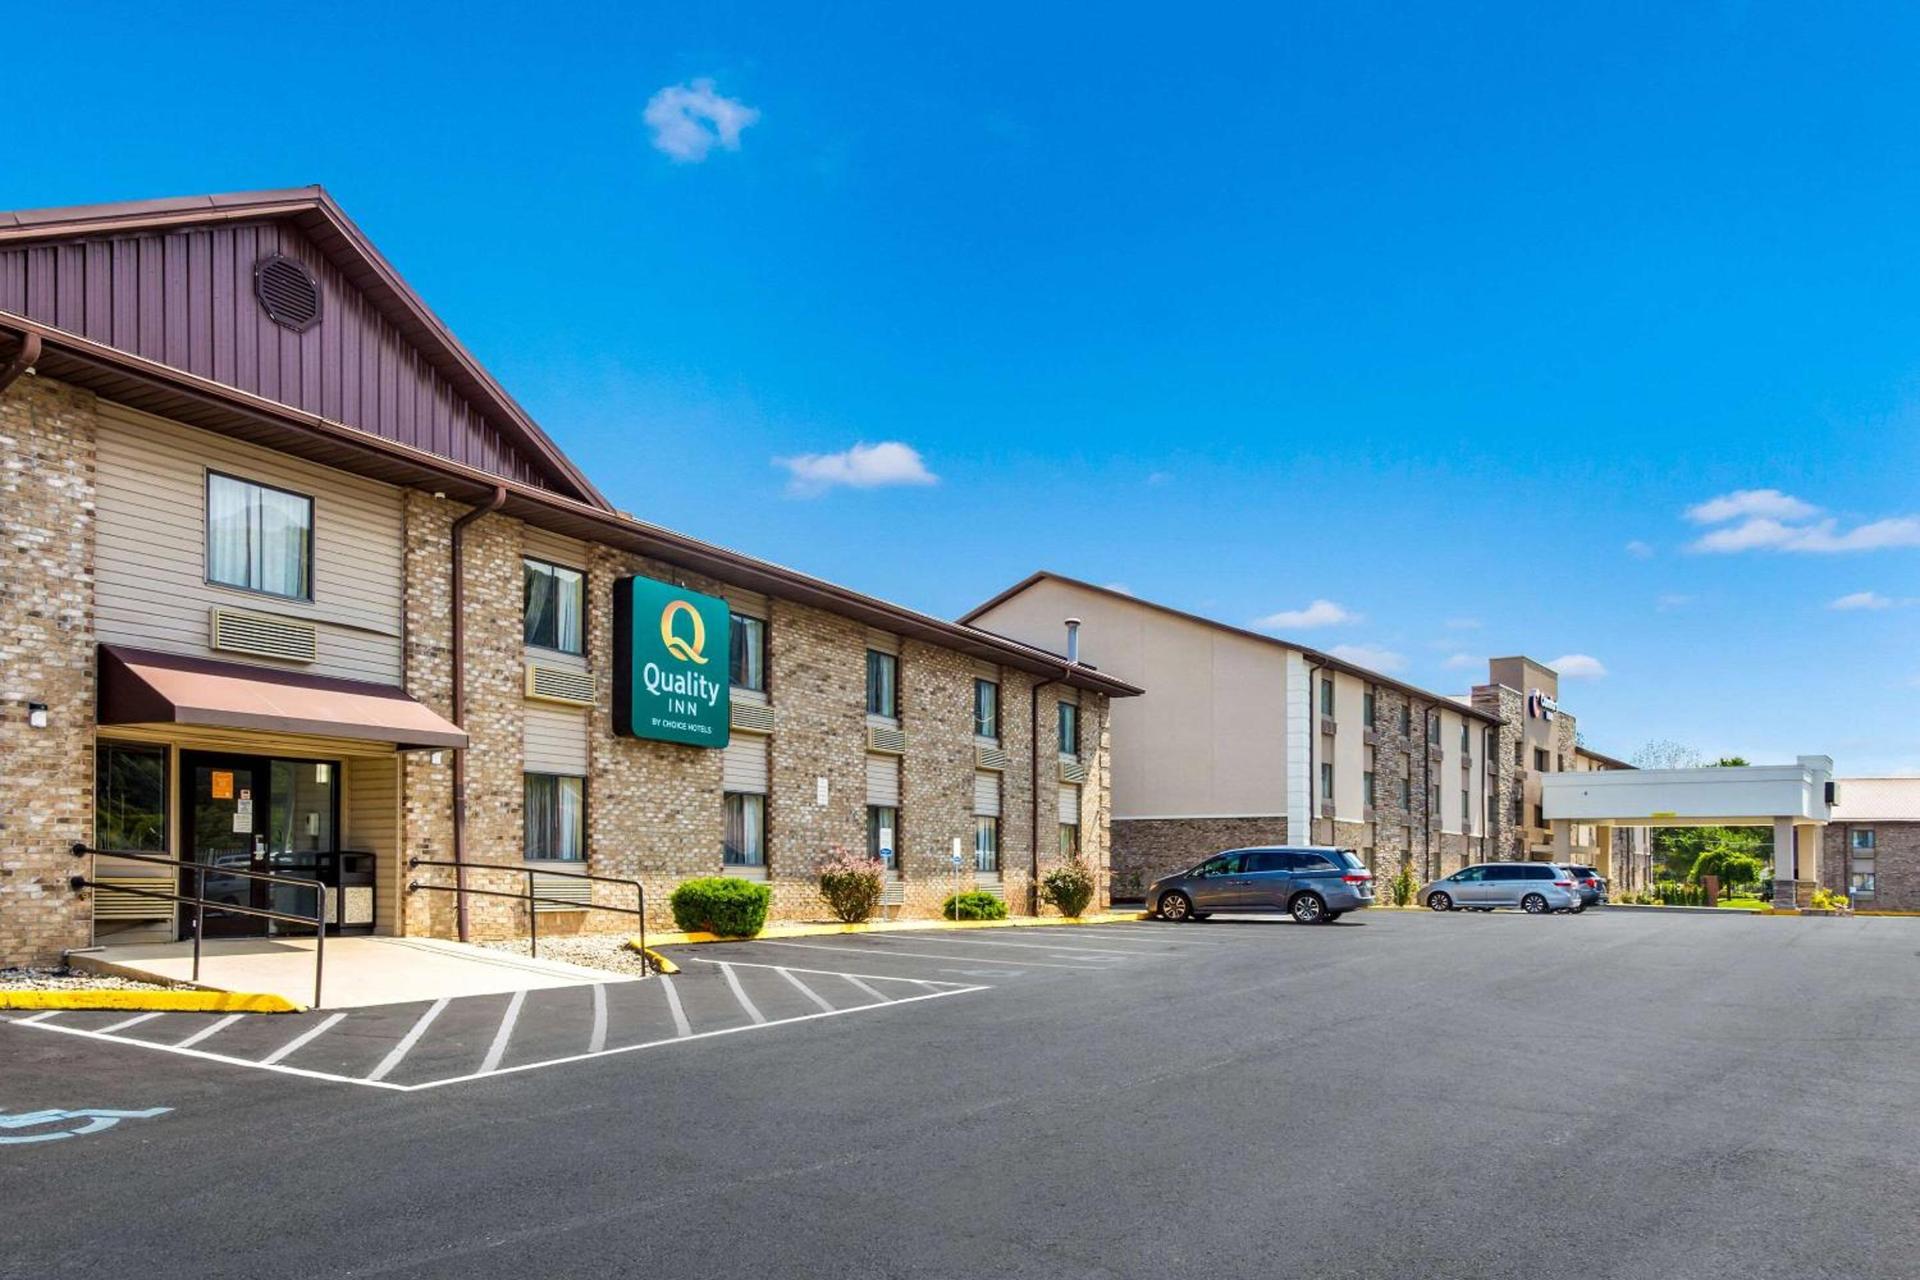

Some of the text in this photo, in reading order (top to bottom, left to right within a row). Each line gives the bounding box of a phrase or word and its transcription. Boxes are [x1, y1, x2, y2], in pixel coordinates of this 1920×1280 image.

[660, 600, 709, 665] Q
[643, 662, 720, 707] Quality
[668, 698, 697, 716] INN
[652, 717, 713, 735] BY CHOICE HOTELS
